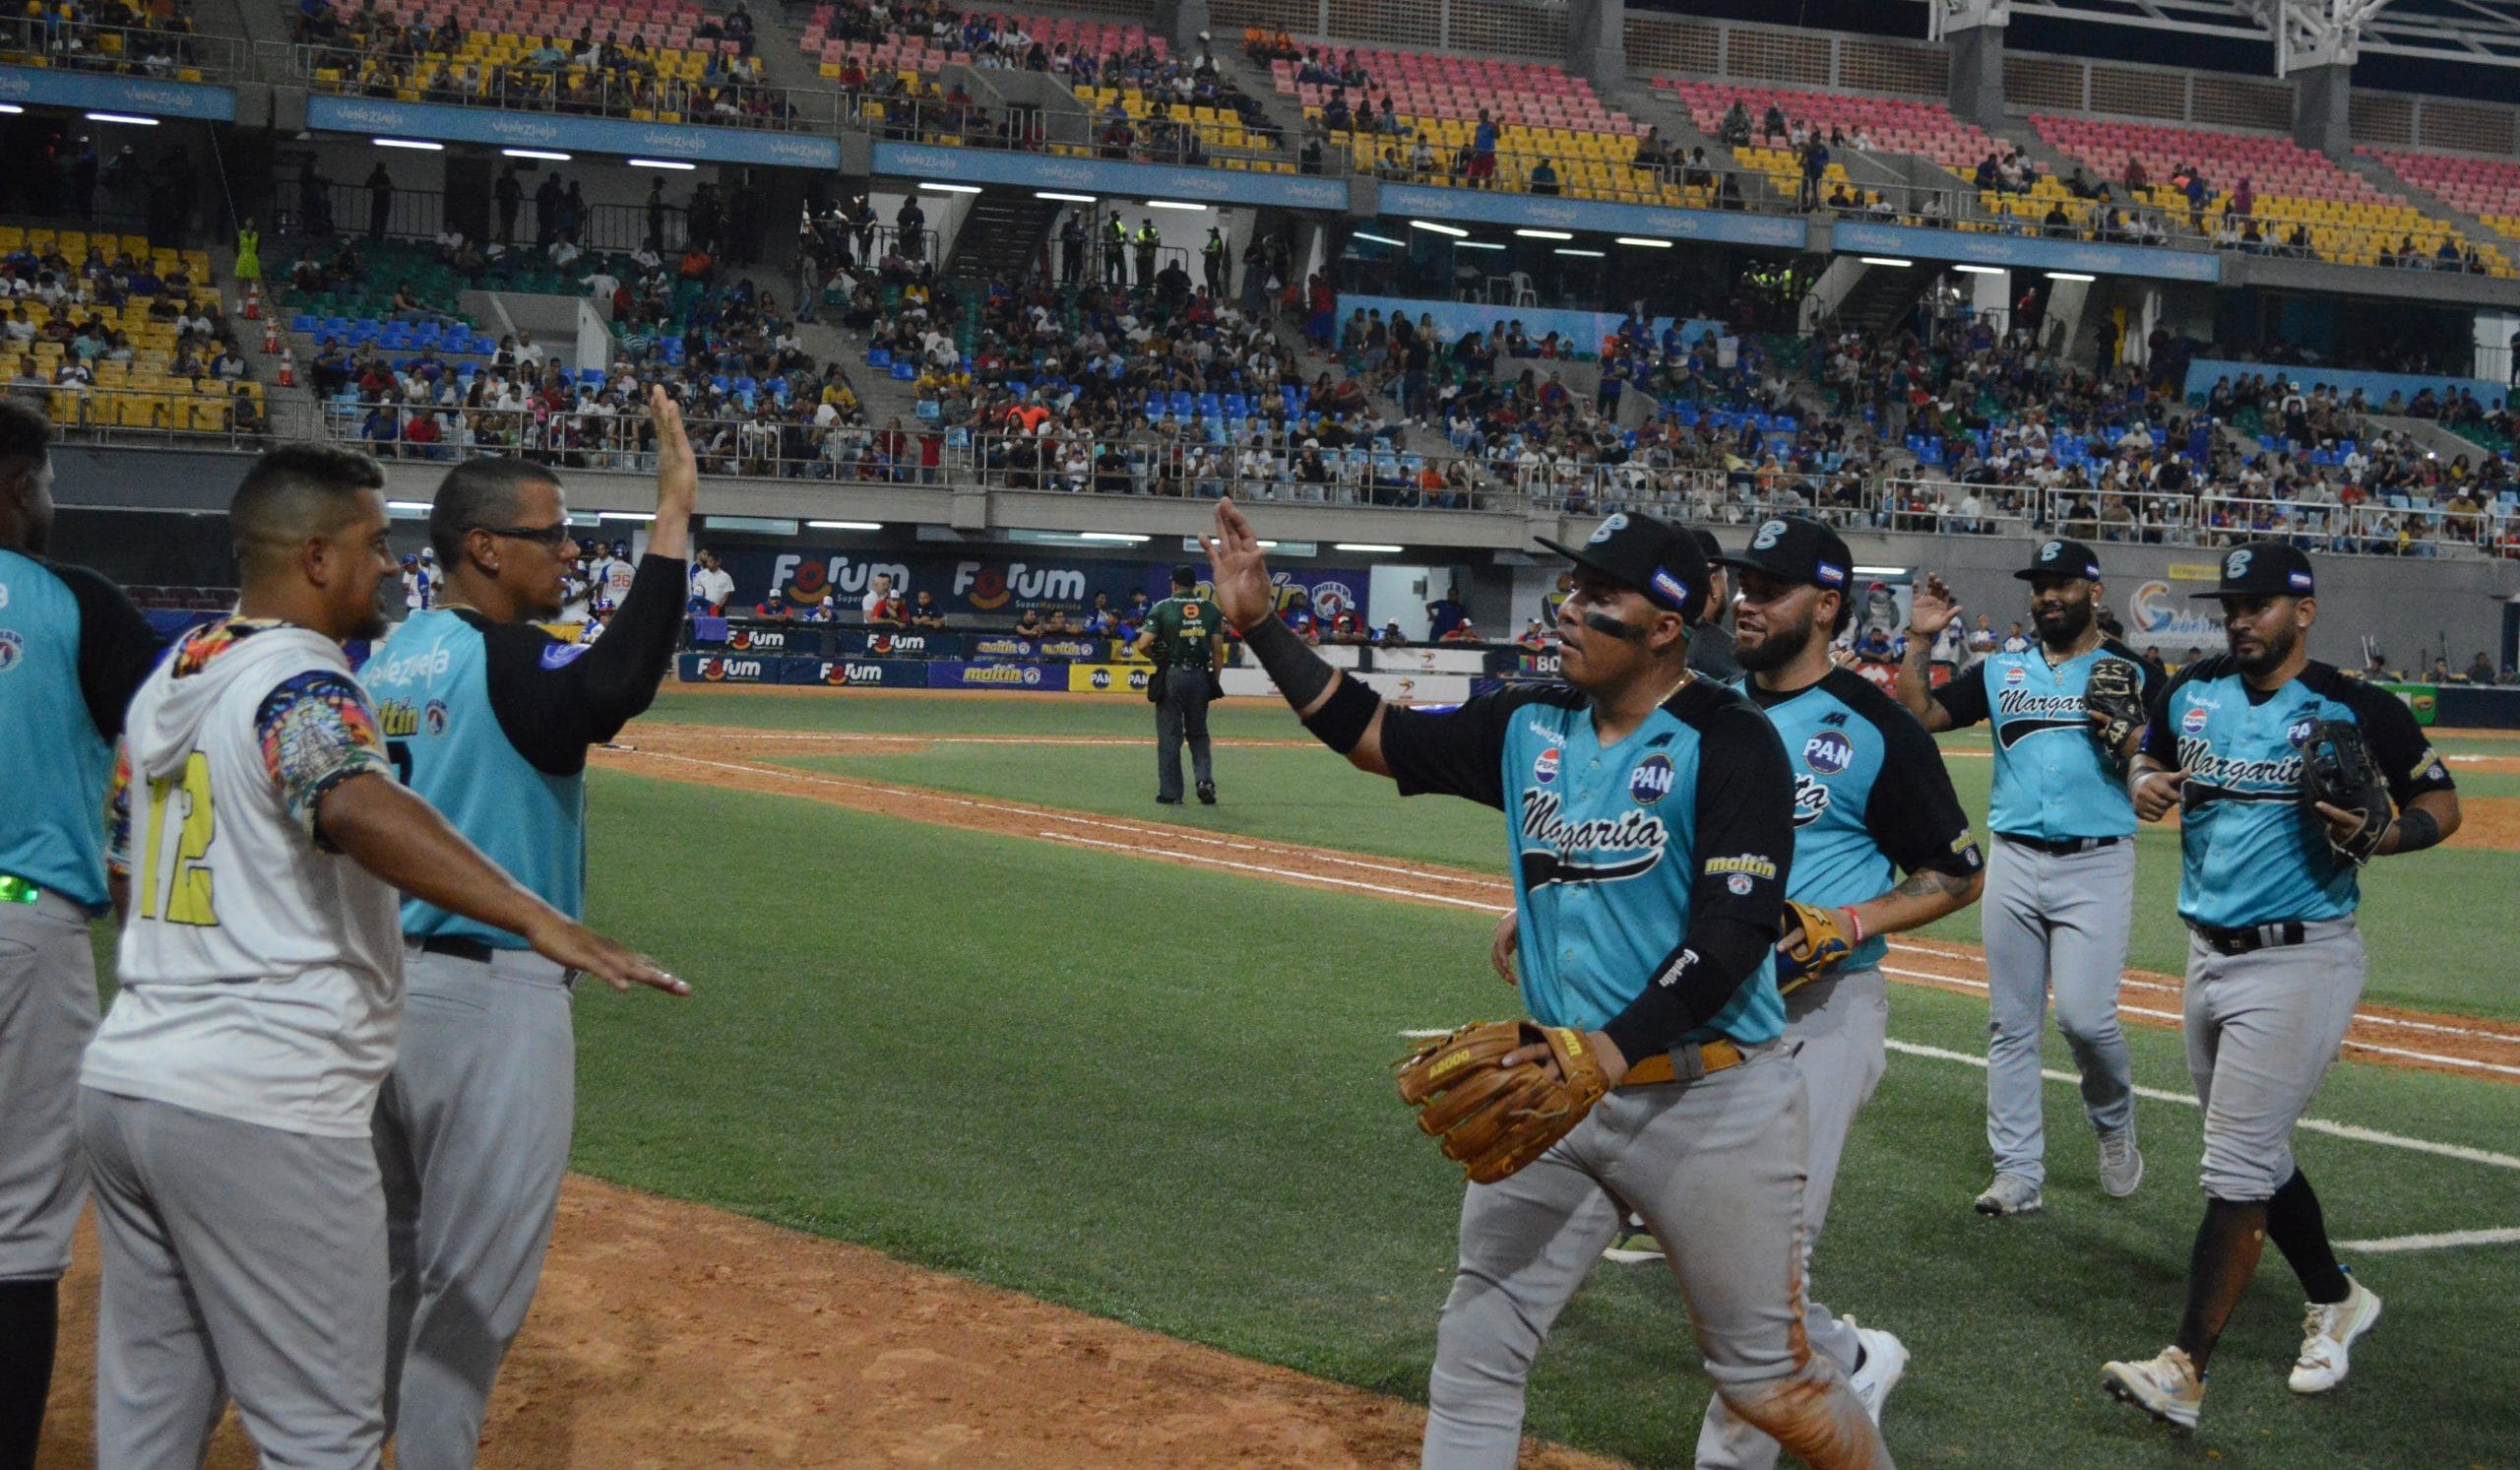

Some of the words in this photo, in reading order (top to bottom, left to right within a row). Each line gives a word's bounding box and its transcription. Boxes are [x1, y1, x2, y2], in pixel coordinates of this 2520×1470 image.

[612, 574, 630, 587] 26
[954, 561, 1085, 604] Forum
[868, 633, 924, 653] Forum
[697, 658, 761, 681] Forum
[820, 663, 882, 684] Forum
[1998, 687, 2087, 719] Margar
[2287, 724, 2311, 739] PA
[1538, 759, 1559, 771] PEPS
[2177, 735, 2303, 788] Margarit
